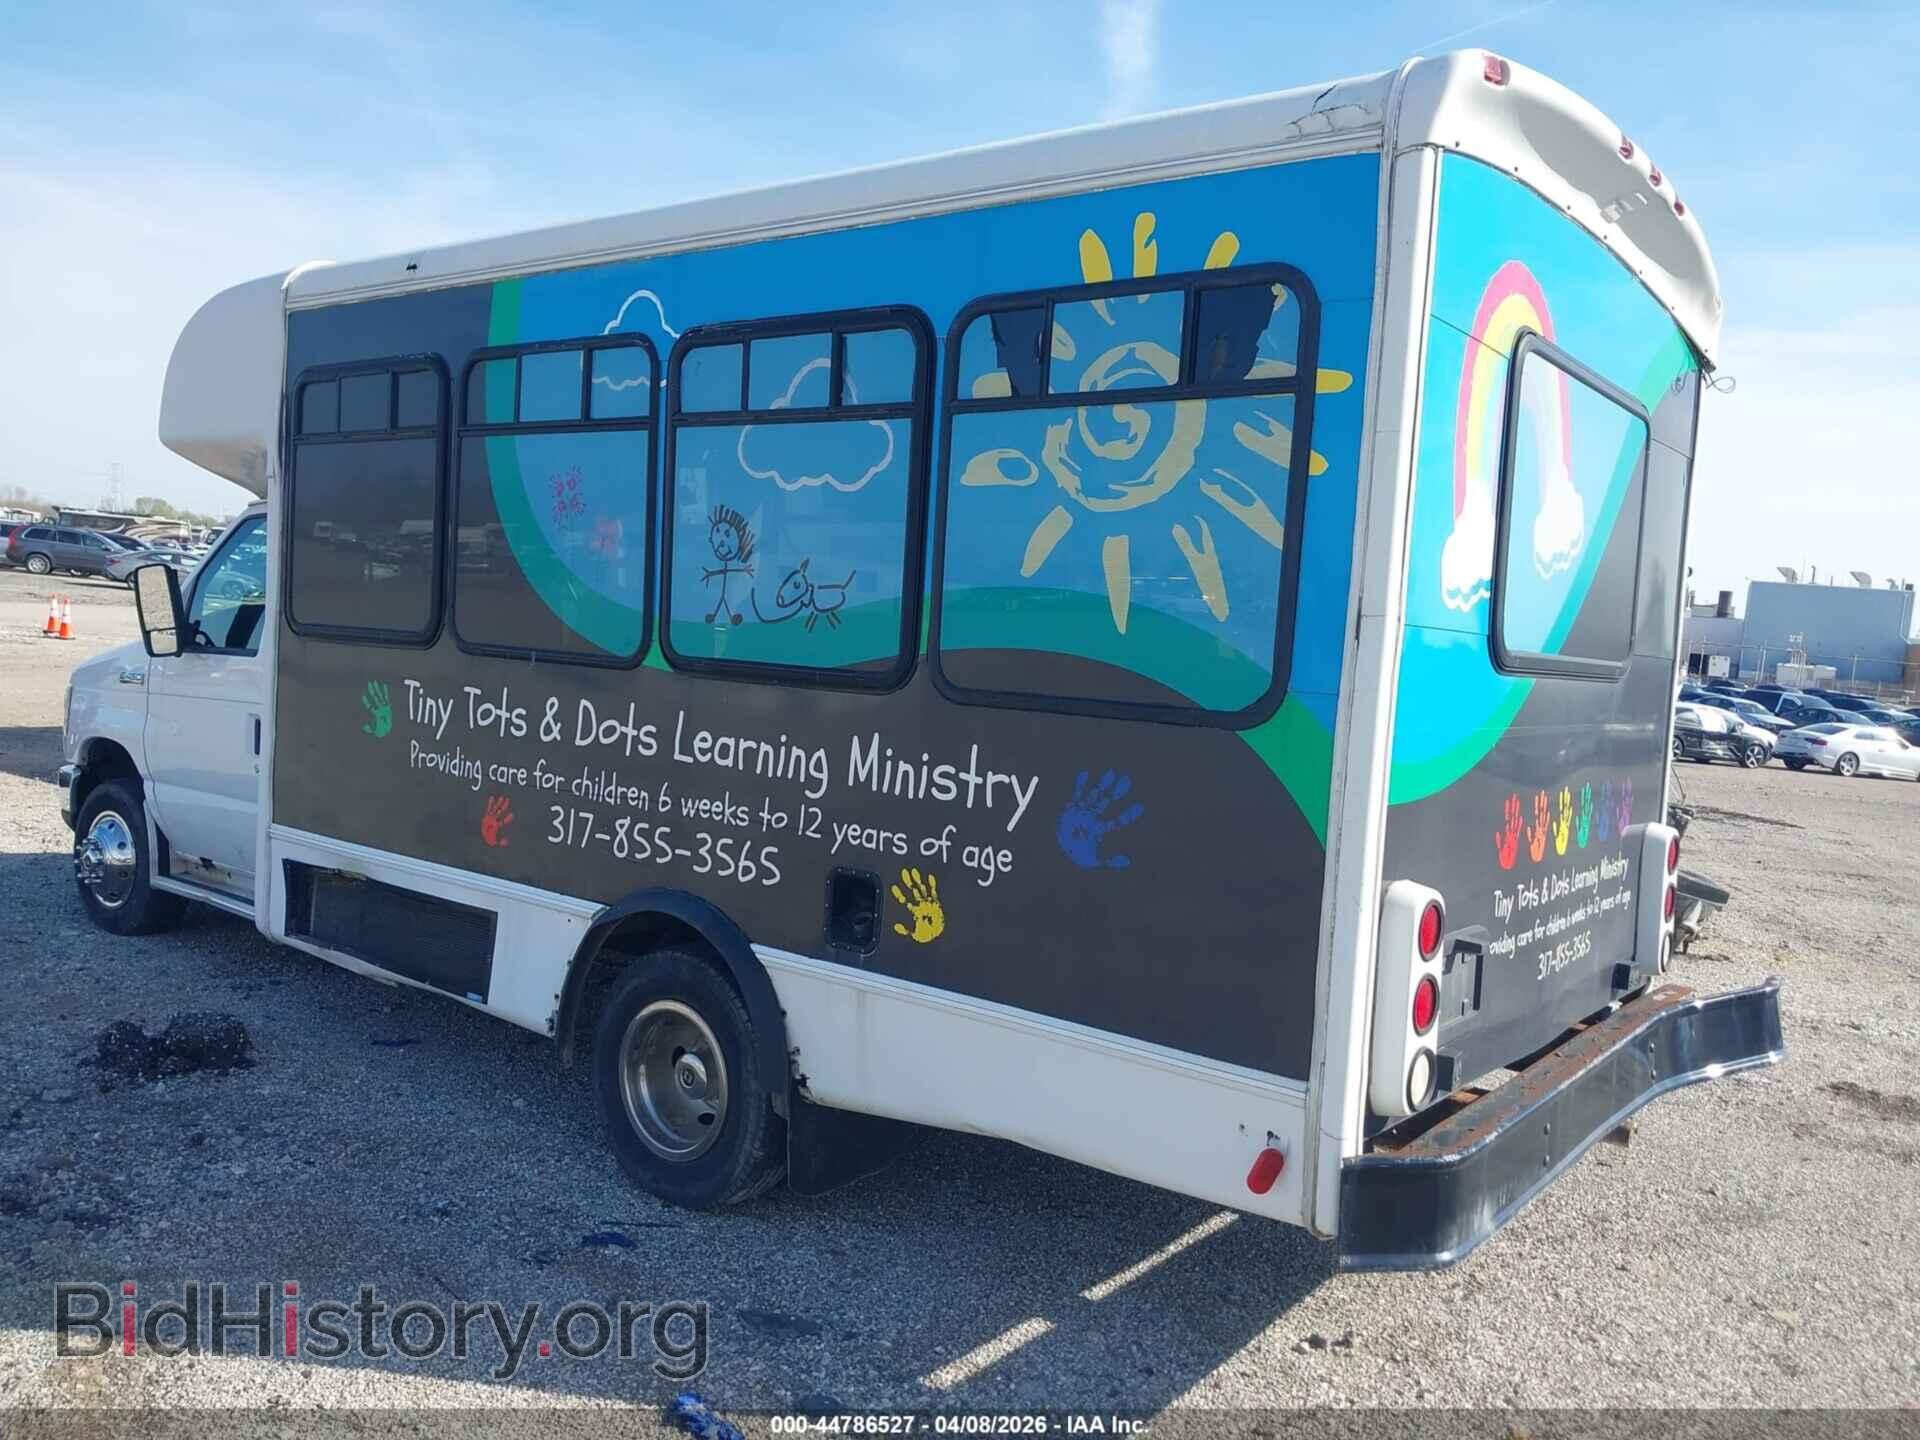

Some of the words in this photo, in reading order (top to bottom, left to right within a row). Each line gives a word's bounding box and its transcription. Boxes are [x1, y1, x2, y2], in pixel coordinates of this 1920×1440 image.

[404, 679, 454, 740] Tiny
[463, 686, 527, 738] Tots
[539, 696, 562, 742] &
[574, 698, 658, 757] Dots
[673, 709, 829, 799] Learning
[848, 732, 1039, 832] Ministry
[410, 739, 483, 791] Providing
[488, 763, 527, 786] care
[532, 758, 565, 793] for
[571, 766, 649, 812] children
[658, 781, 672, 813] 6
[680, 791, 749, 827] weeks
[758, 796, 788, 833] to
[798, 804, 823, 839] 12
[831, 822, 909, 856] years
[919, 824, 957, 863] of
[962, 846, 1013, 887] age
[547, 805, 782, 887] 317-855-3565
[1494, 889, 1514, 925] Tiny
[1517, 878, 1539, 910] Tots
[1541, 876, 1550, 904] &
[1550, 868, 1570, 901] Dots
[1571, 865, 1599, 894] Learning
[1600, 849, 1629, 881] Ministry
[1489, 930, 1516, 959] oviding
[1517, 929, 1534, 947] care
[1534, 918, 1546, 942] for
